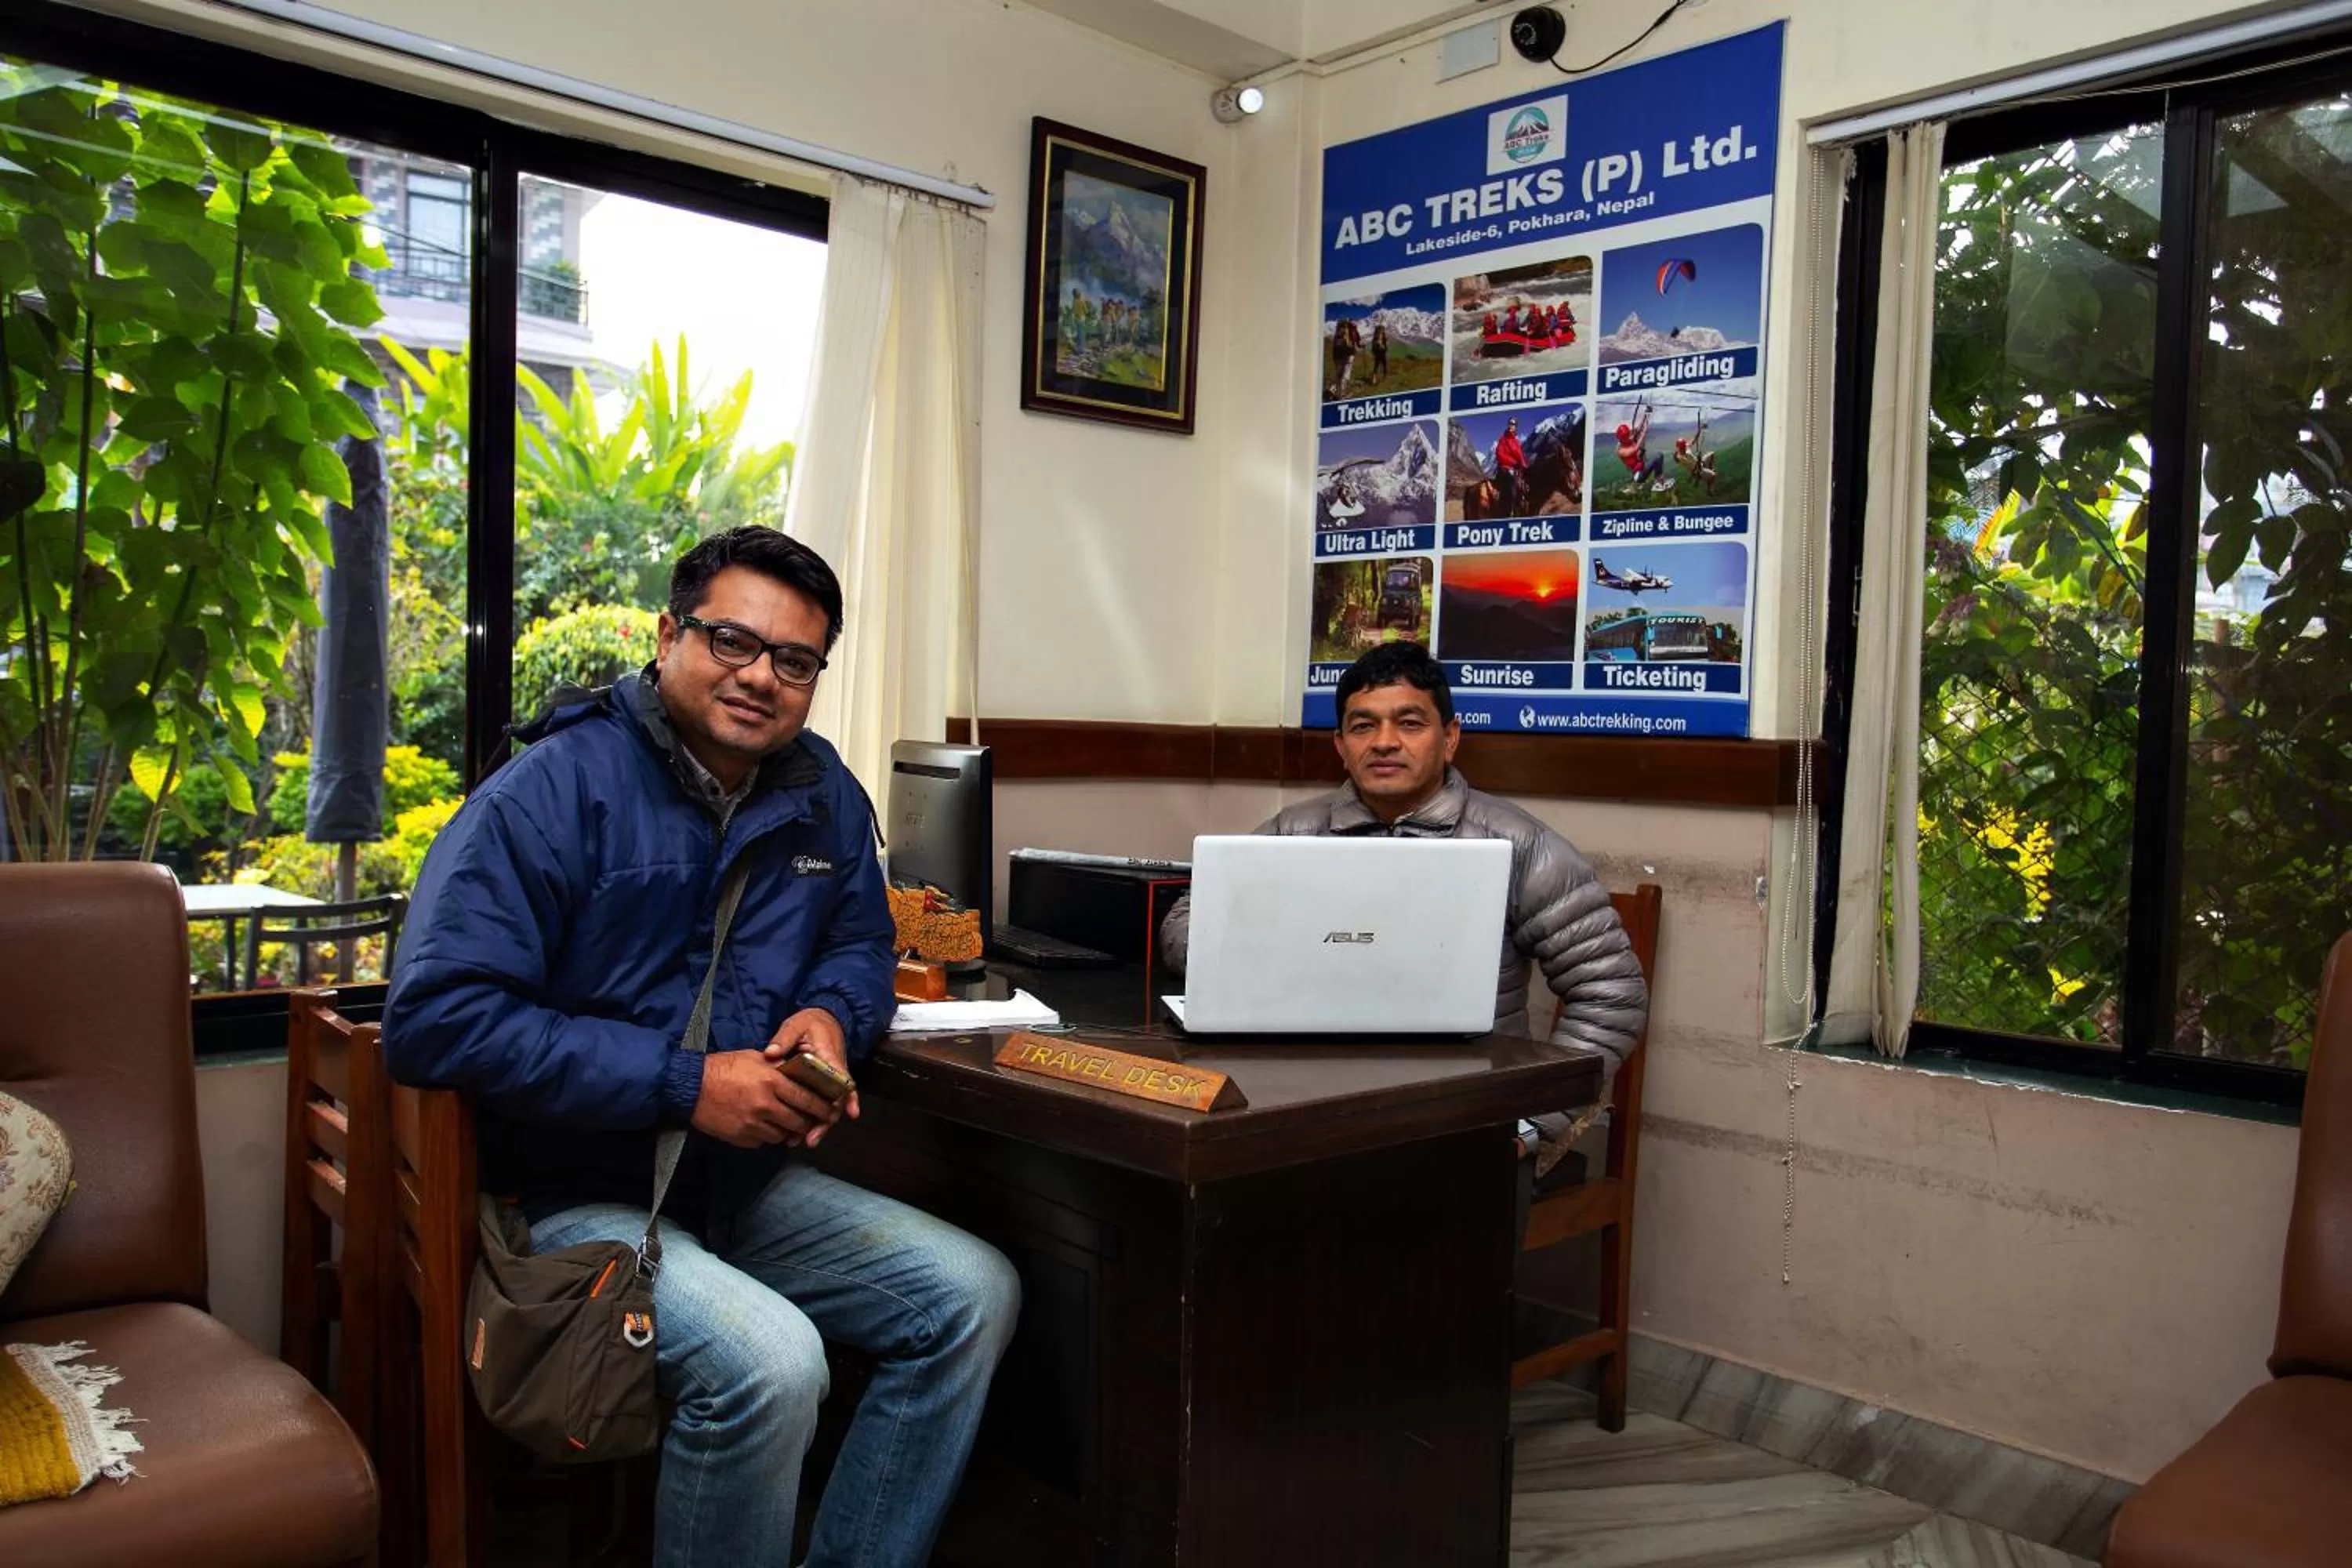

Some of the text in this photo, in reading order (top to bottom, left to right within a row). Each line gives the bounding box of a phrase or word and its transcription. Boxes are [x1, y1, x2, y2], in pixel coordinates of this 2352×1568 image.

[1334, 125, 1757, 249] ABC TREKS (P) Ltd.
[1406, 191, 1656, 256] Lakeside-6, Pokhara, Nepal
[1605, 354, 1735, 388] Paragliding
[1476, 379, 1547, 405] Rafting
[1338, 398, 1414, 422] Trekking
[1457, 521, 1553, 546] Pony Trek
[1602, 513, 1734, 536] Zipline & Bungee
[1325, 528, 1415, 553] Ultra Light
[1461, 664, 1534, 686] Sunrise
[1602, 665, 1708, 691] Ticketing
[1537, 712, 1686, 733] www.abctrekking.com
[1323, 931, 1374, 943] ASUS
[1020, 1043, 1207, 1095] TRAVEL DESK
